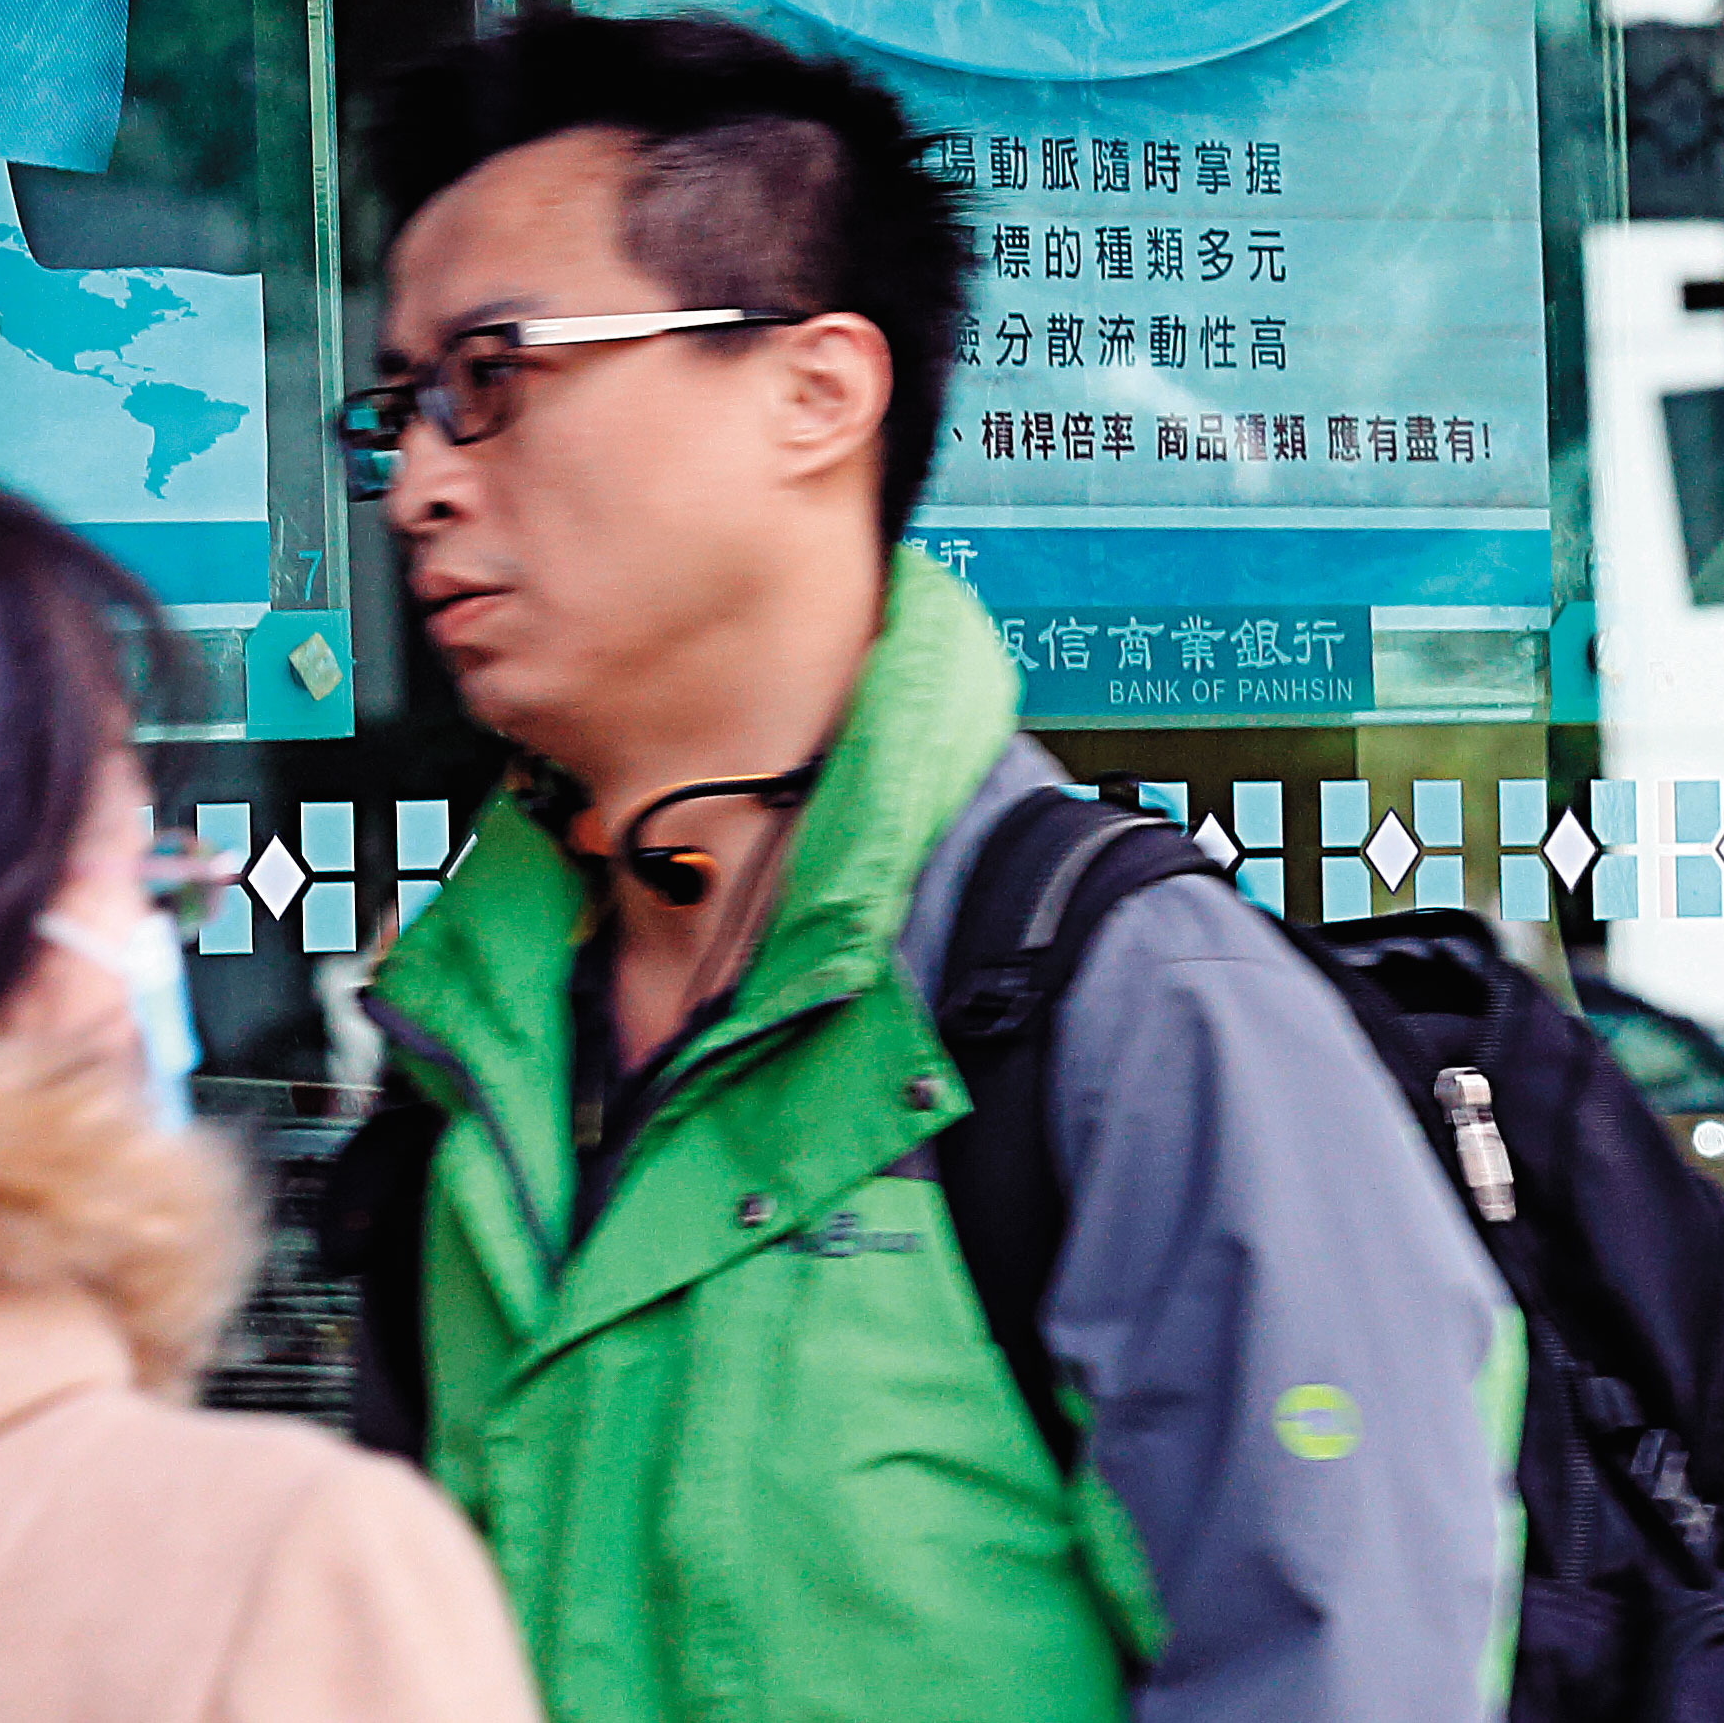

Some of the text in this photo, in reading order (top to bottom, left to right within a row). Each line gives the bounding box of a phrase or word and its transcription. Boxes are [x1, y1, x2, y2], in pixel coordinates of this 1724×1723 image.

[991, 223, 1287, 283] 標的種類多元
[1156, 413, 1308, 464] 商品種類
[1109, 677, 1355, 705] BANK OF PANHSIN
